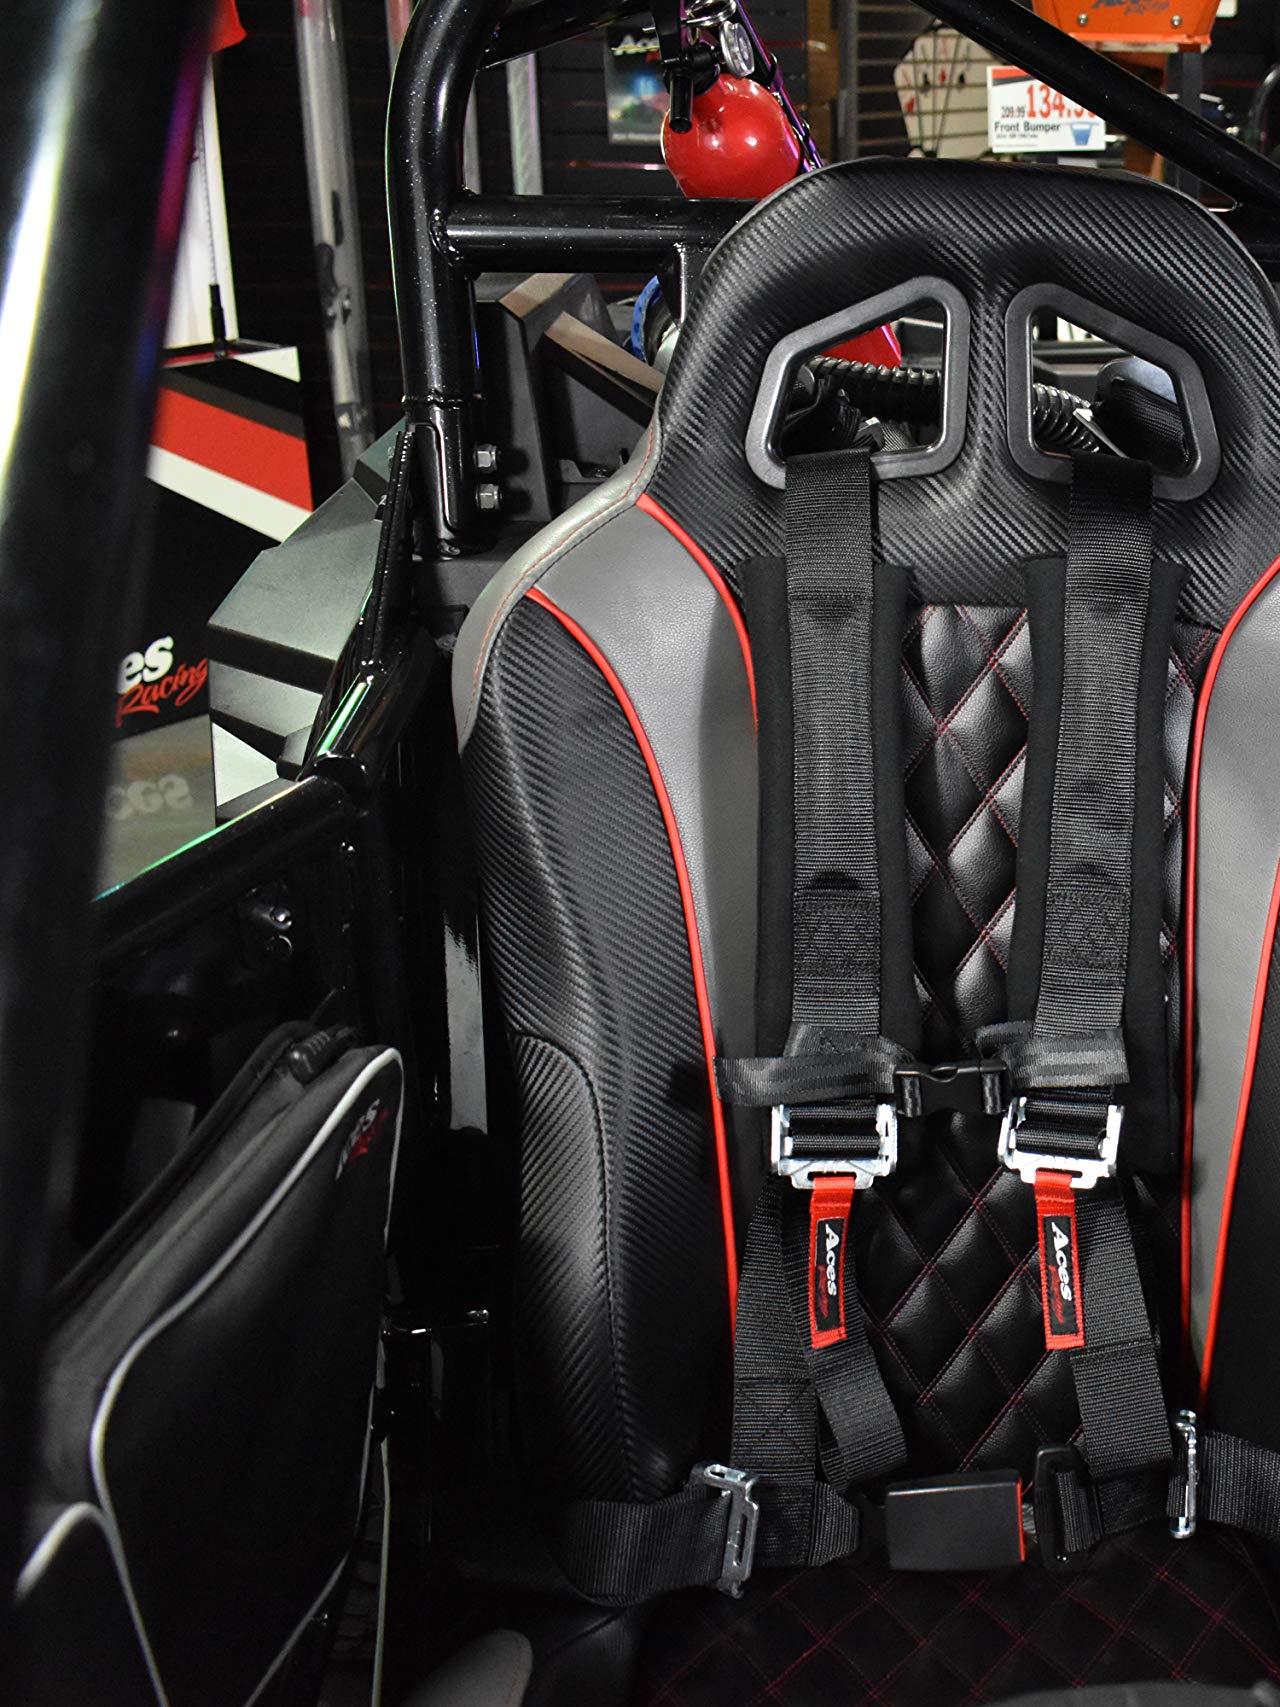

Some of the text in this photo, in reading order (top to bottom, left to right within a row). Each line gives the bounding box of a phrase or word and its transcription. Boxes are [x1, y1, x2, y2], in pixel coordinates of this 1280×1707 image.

[994, 121, 1061, 133] Front Bumper
[1027, 83, 1096, 119] 134.
[115, 657, 209, 728] Racing
[825, 1223, 840, 1296] Aces
[1051, 1221, 1072, 1301] Aces
